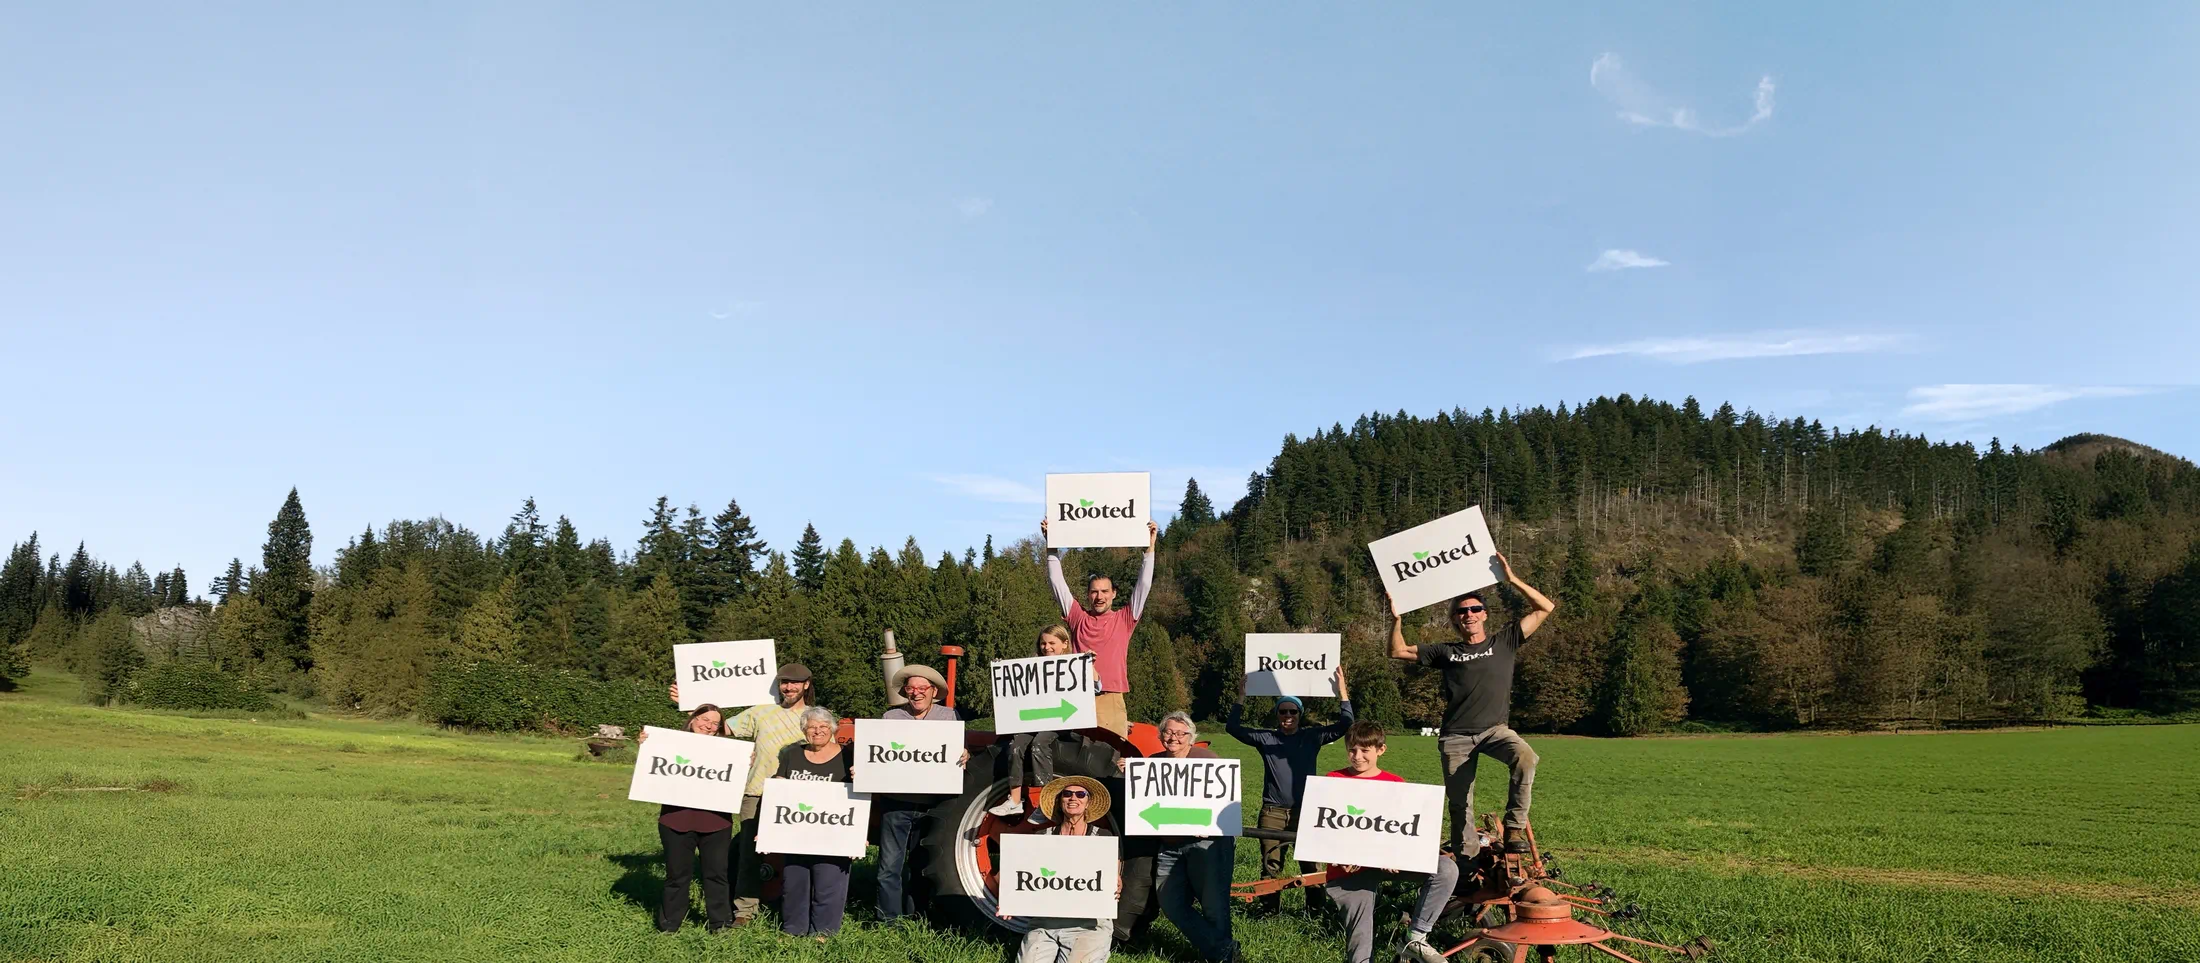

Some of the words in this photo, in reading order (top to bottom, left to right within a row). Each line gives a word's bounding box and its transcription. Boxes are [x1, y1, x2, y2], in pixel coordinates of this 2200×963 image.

[1058, 498, 1136, 522] Rooted
[1392, 534, 1480, 583] Rooted
[691, 657, 766, 683] Rooted
[1257, 653, 1326, 671] Rooted
[993, 655, 1091, 697] FARMFEST
[868, 743, 947, 764] Rooted
[649, 756, 733, 783] Rooted
[789, 769, 834, 783] Rooted
[1129, 761, 1240, 802] FARMFEST
[774, 805, 855, 827] Rooted
[1313, 806, 1421, 838] Rooted
[1015, 870, 1103, 892] Rooted
